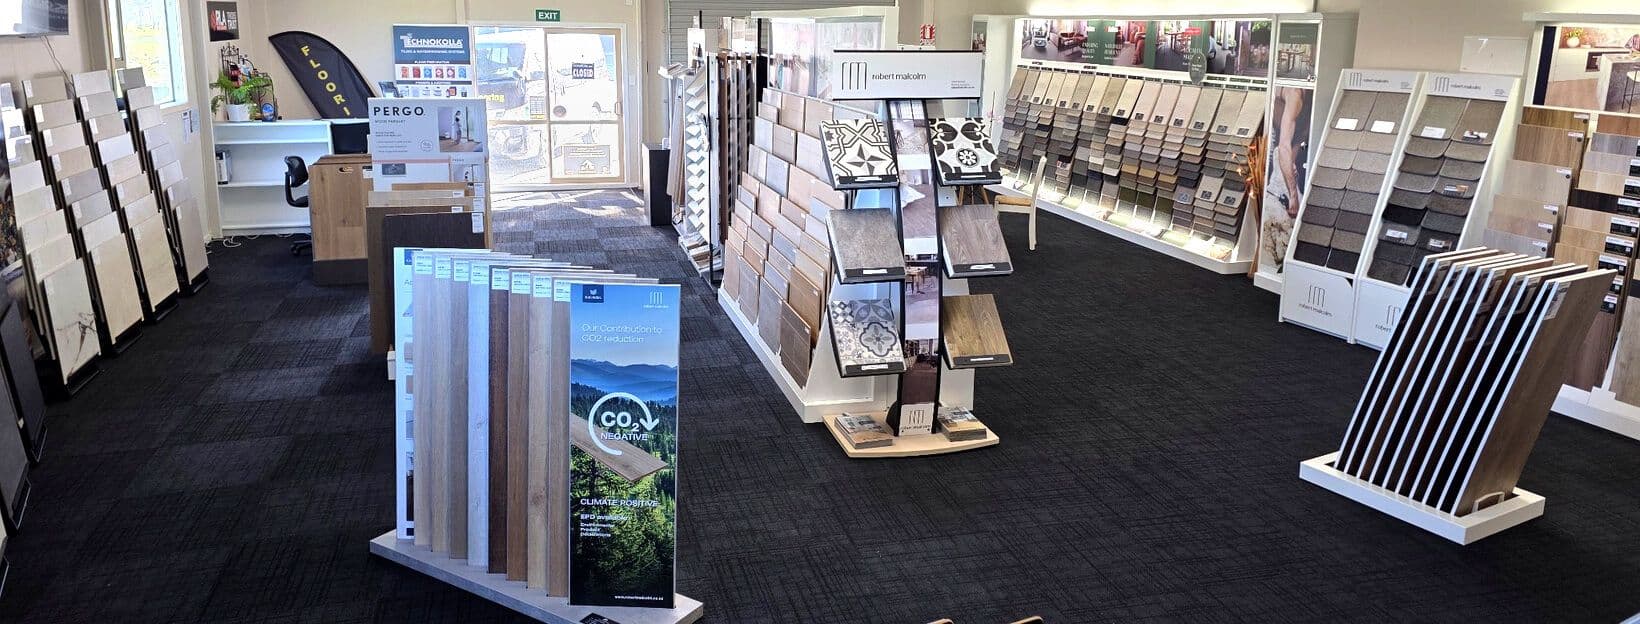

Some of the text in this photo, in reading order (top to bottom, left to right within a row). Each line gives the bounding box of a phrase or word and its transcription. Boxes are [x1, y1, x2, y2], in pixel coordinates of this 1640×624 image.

[538, 11, 558, 20] EXIT
[872, 72, 927, 80] robert malcolm
[373, 106, 424, 116] PERGO
[599, 323, 653, 334] Contribution
[653, 325, 662, 334] to
[600, 411, 640, 432] CO2
[600, 432, 649, 441] NEGATIVE
[580, 498, 658, 507] CLIMATE POSITIVE
